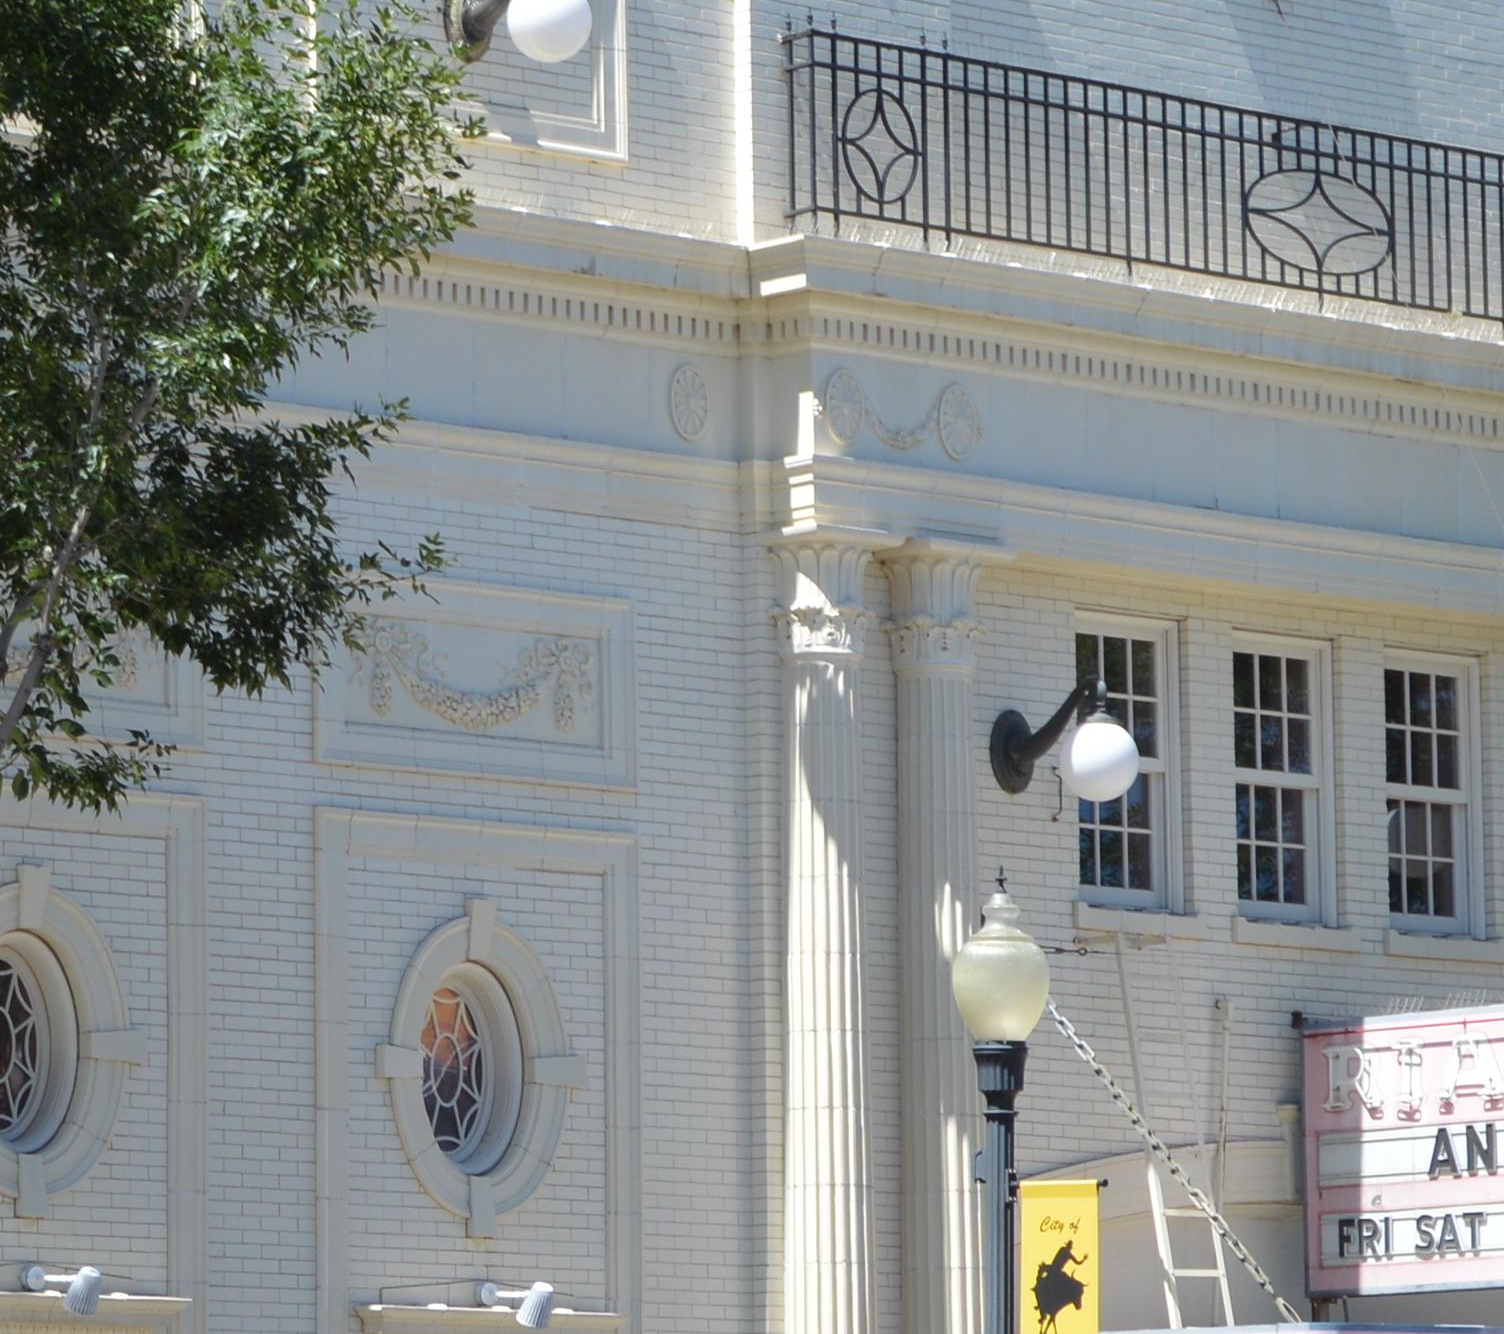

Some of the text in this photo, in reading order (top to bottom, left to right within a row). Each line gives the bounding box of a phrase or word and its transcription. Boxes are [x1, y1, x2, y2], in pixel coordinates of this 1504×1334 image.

[1039, 1215, 1082, 1235] City of
[1338, 1216, 1394, 1262] FRI
[1414, 1211, 1488, 1261] SAT
